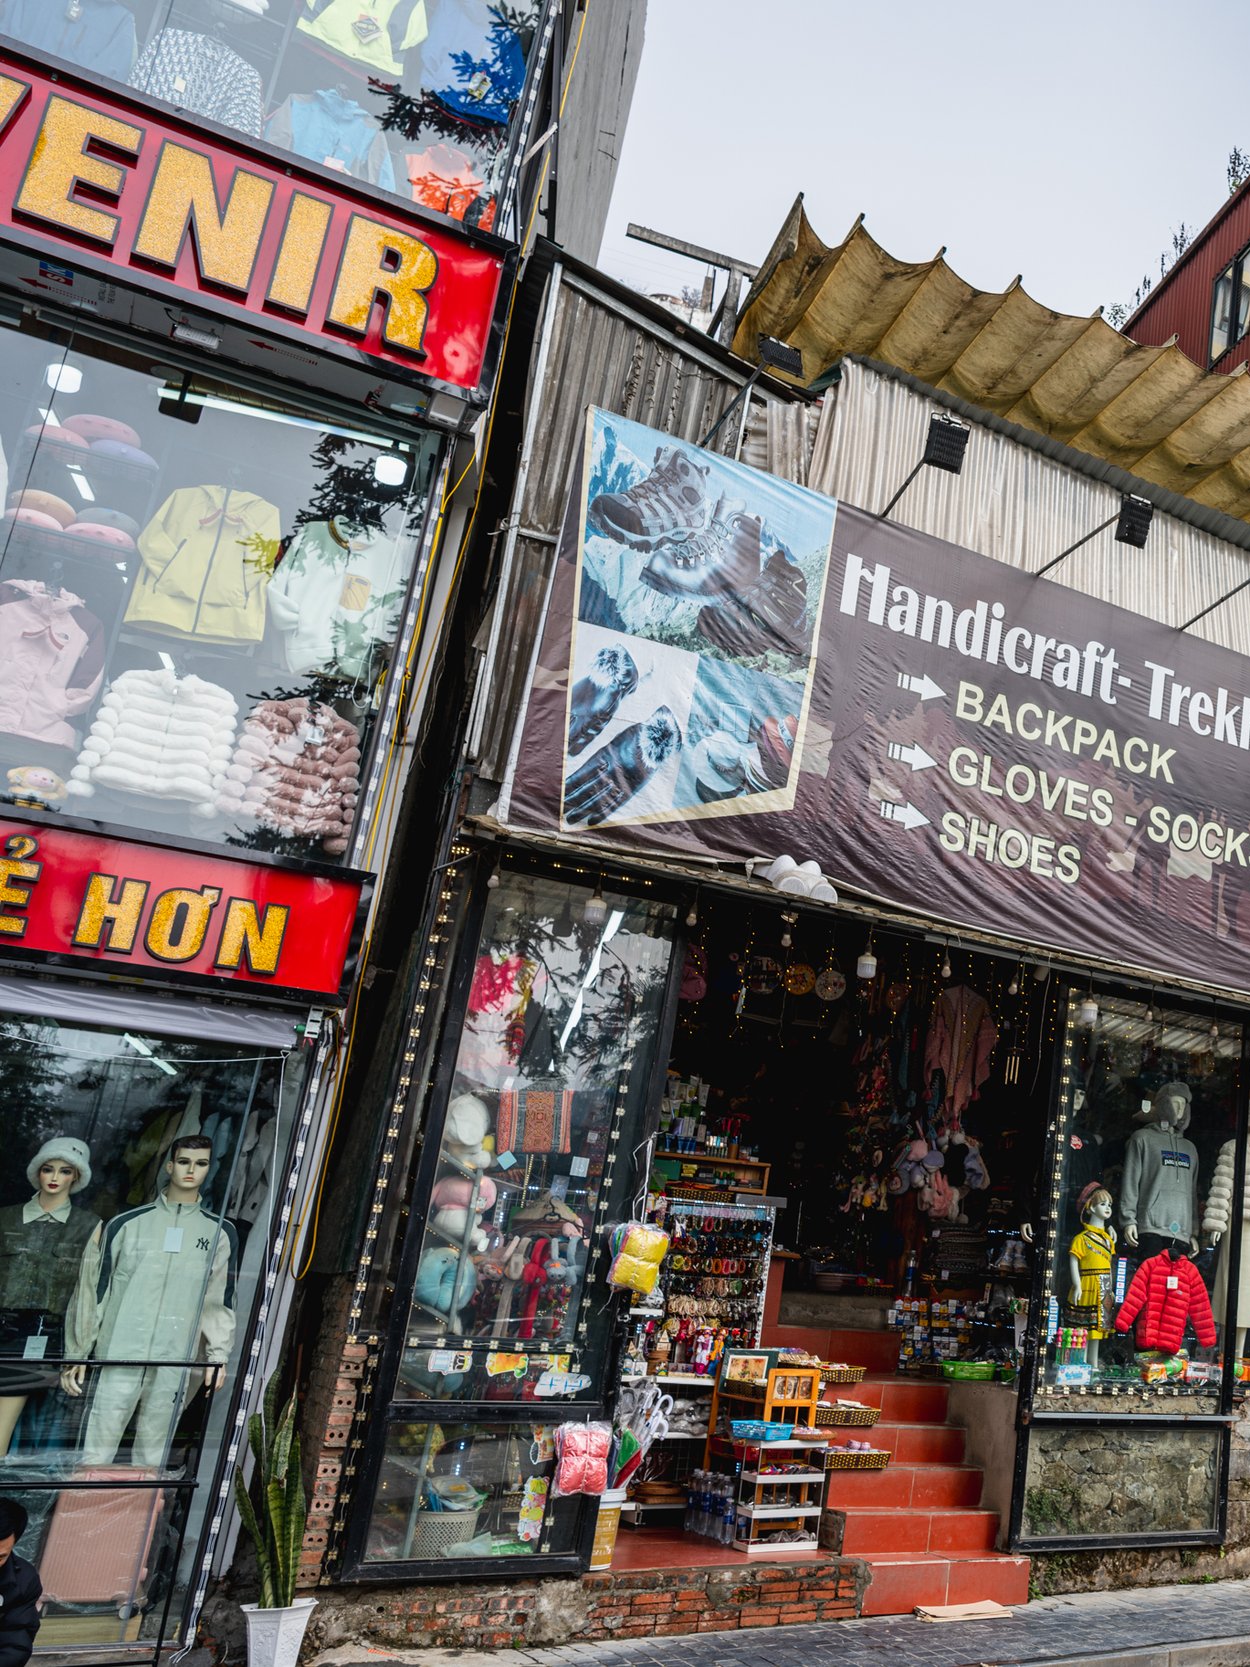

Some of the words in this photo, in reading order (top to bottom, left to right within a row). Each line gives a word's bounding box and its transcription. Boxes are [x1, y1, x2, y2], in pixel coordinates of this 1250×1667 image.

[955, 683, 1176, 785] BACKPACK
[948, 745, 1113, 827] GLOVES
[939, 812, 1083, 884] SHOES
[72, 872, 291, 975] HƠN
